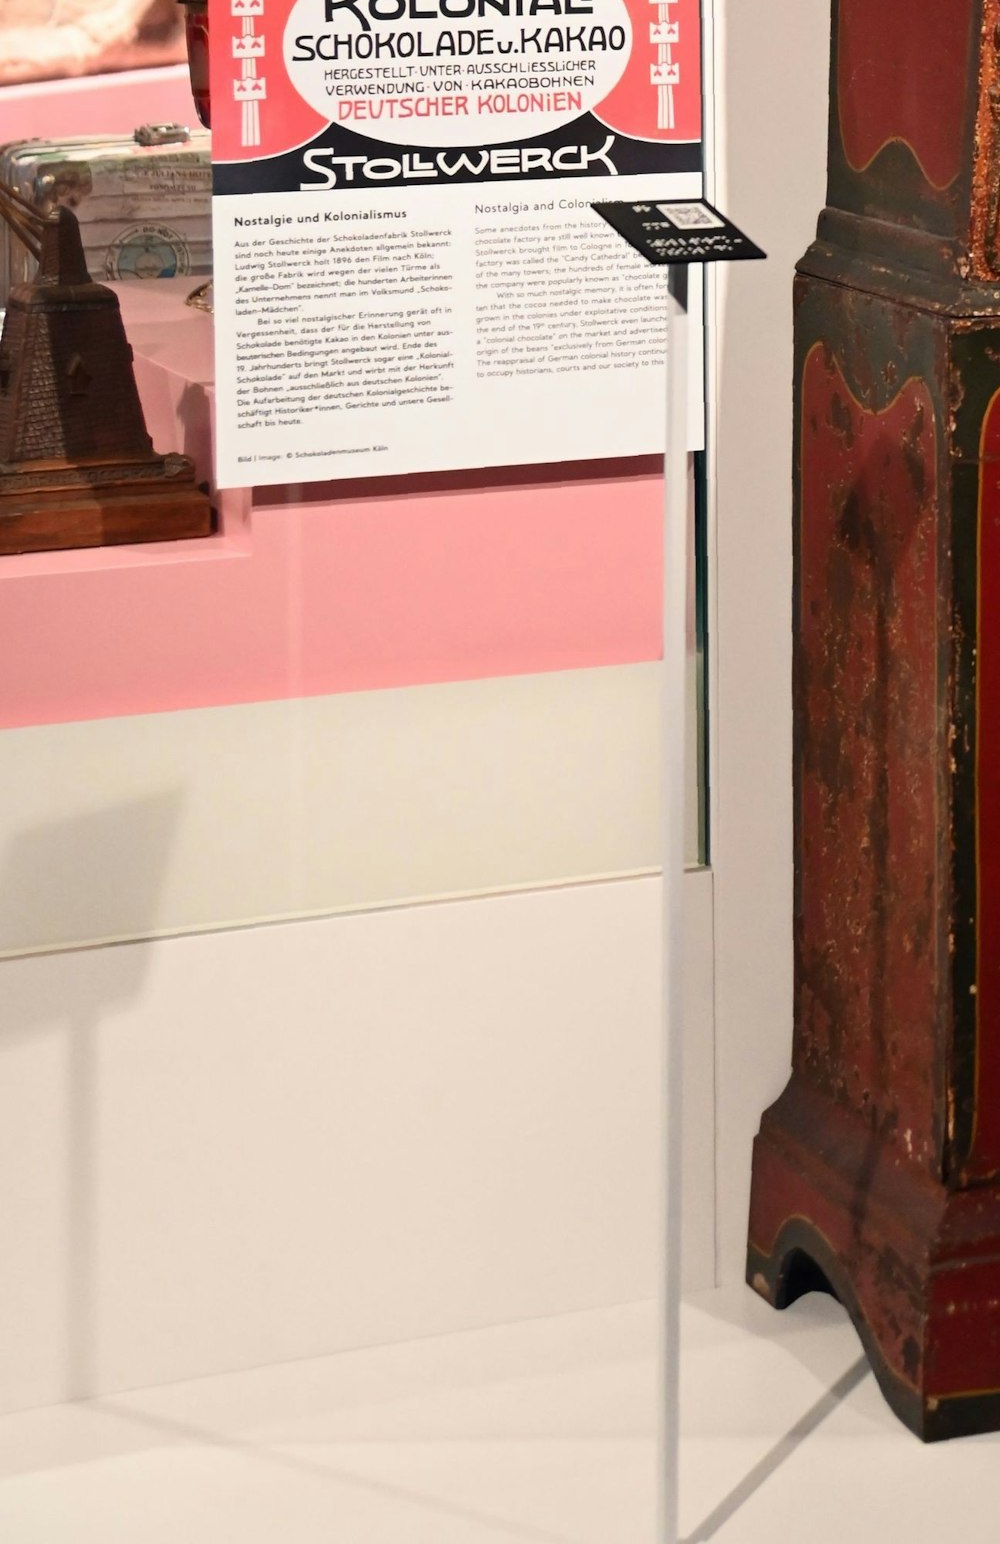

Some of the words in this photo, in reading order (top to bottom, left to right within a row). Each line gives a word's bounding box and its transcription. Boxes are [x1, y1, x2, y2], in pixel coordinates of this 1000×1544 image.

[292, 29, 494, 61] SCHOKOLADE
[520, 25, 626, 53] KAKAO
[324, 66, 415, 80] HERGESTELLT
[420, 64, 462, 77] UNTER
[325, 82, 425, 96] VERWENDUNG
[433, 80, 463, 92] VON
[471, 76, 595, 91] KAKAOBOHNEN
[338, 96, 469, 121] DEUTSCHER
[300, 135, 619, 191] STOLLWERCK
[474, 202, 529, 214] Nostalgia
[533, 200, 554, 211] and
[234, 214, 292, 227] Nostalgie
[297, 212, 319, 223] und
[324, 210, 407, 221] Kolonialismus
[268, 237, 314, 245] Geschichte
[332, 232, 407, 241] Schokoladenfabrik
[410, 229, 451, 237] Stollwerck
[234, 251, 251, 259] sind
[301, 248, 327, 256] einige
[376, 243, 414, 252] allgemein
[267, 259, 311, 268] Stollwerck
[332, 256, 352, 264] 1896
[372, 254, 390, 262] Film
[392, 253, 411, 261] nach
[234, 274, 247, 282] die
[250, 272, 275, 283] große
[327, 269, 355, 277] wegen
[343, 278, 356, 286] die
[251, 294, 311, 303] Unternehmens
[371, 286, 414, 295] Volksmund
[301, 313, 356, 323] nostalgischer
[358, 311, 404, 319] Erinnerung
[406, 308, 428, 317] gerät
[367, 321, 415, 329] Herstellung
[236, 340, 282, 350] Schokolade
[284, 338, 322, 346] benötigte
[287, 372, 301, 380] auf
[320, 369, 345, 377] Markt
[419, 361, 454, 370] Herkunft
[253, 396, 305, 404] Aufarbeitung
[323, 391, 364, 400] deutschen
[366, 386, 438, 396] Kolonialgeschichte
[237, 420, 262, 429] schaft
